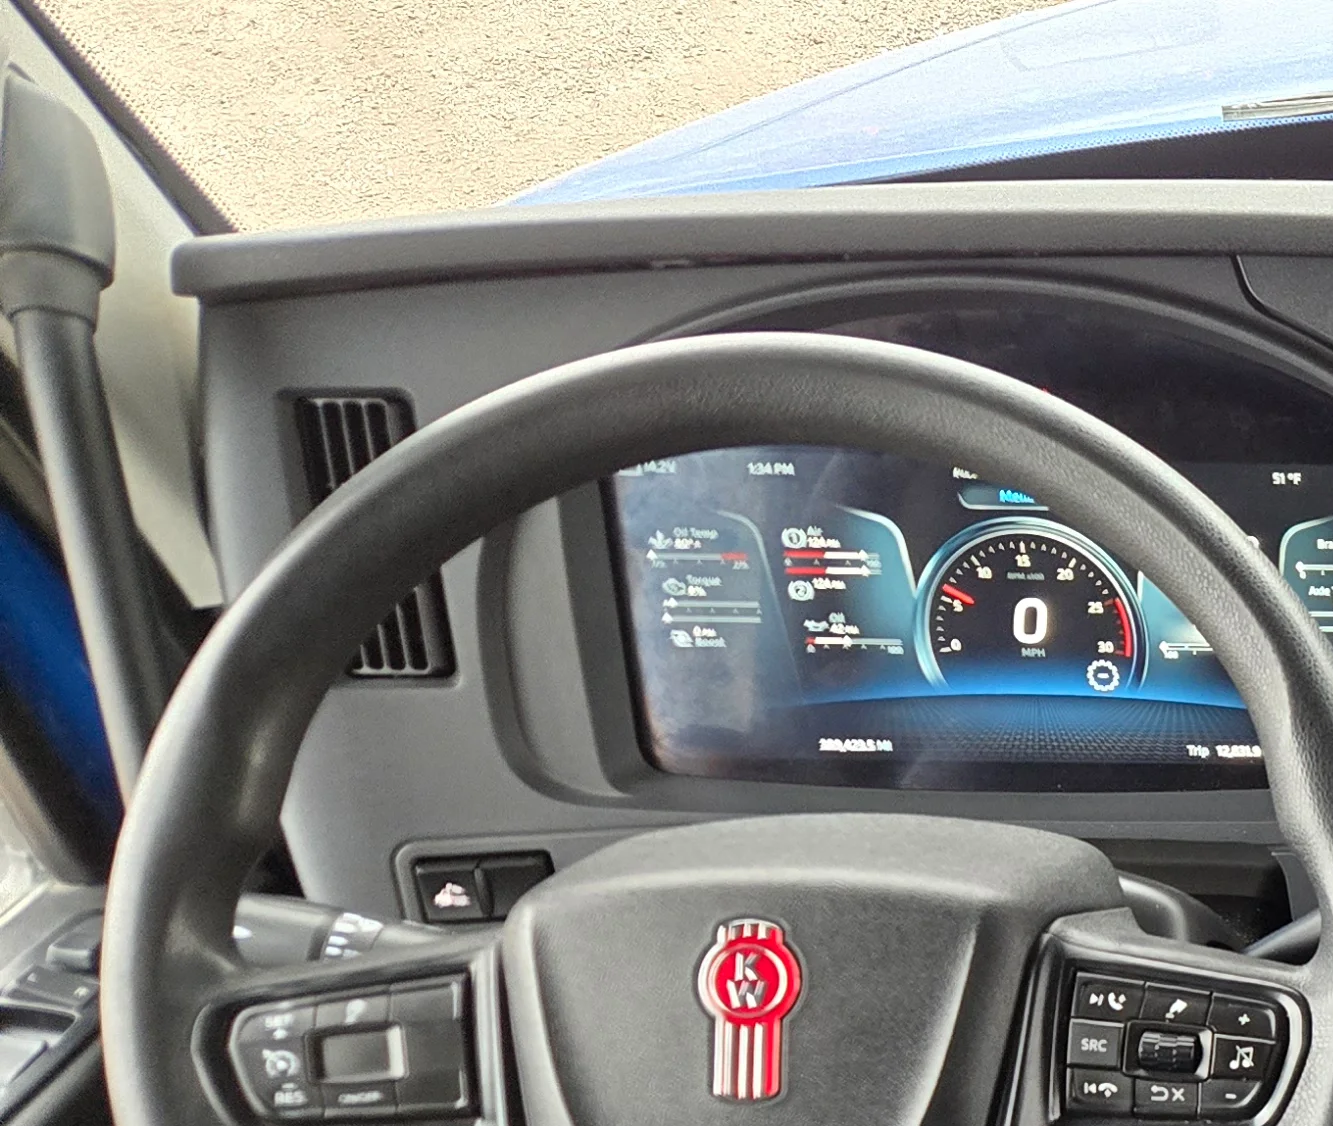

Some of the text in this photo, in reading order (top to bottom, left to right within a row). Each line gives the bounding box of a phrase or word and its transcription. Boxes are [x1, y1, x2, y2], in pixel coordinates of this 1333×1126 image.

[773, 463, 795, 476] PM
[1272, 472, 1285, 485] 51
[673, 527, 718, 540] Oil Temp
[807, 526, 823, 536] Air
[1015, 554, 1031, 568] 15
[976, 567, 992, 579] 10
[1057, 568, 1074, 580] 20
[686, 574, 722, 587] Torque
[1308, 586, 1330, 596] Axle
[953, 599, 963, 612] 5
[1088, 601, 1104, 614] 25
[1013, 597, 1048, 645] 0
[950, 638, 962, 651] 0
[1097, 641, 1114, 653] 30
[1021, 647, 1045, 657] MPH
[1186, 745, 1209, 758] Trip
[1081, 1038, 1107, 1052] SRC
[274, 1091, 307, 1107] RES
